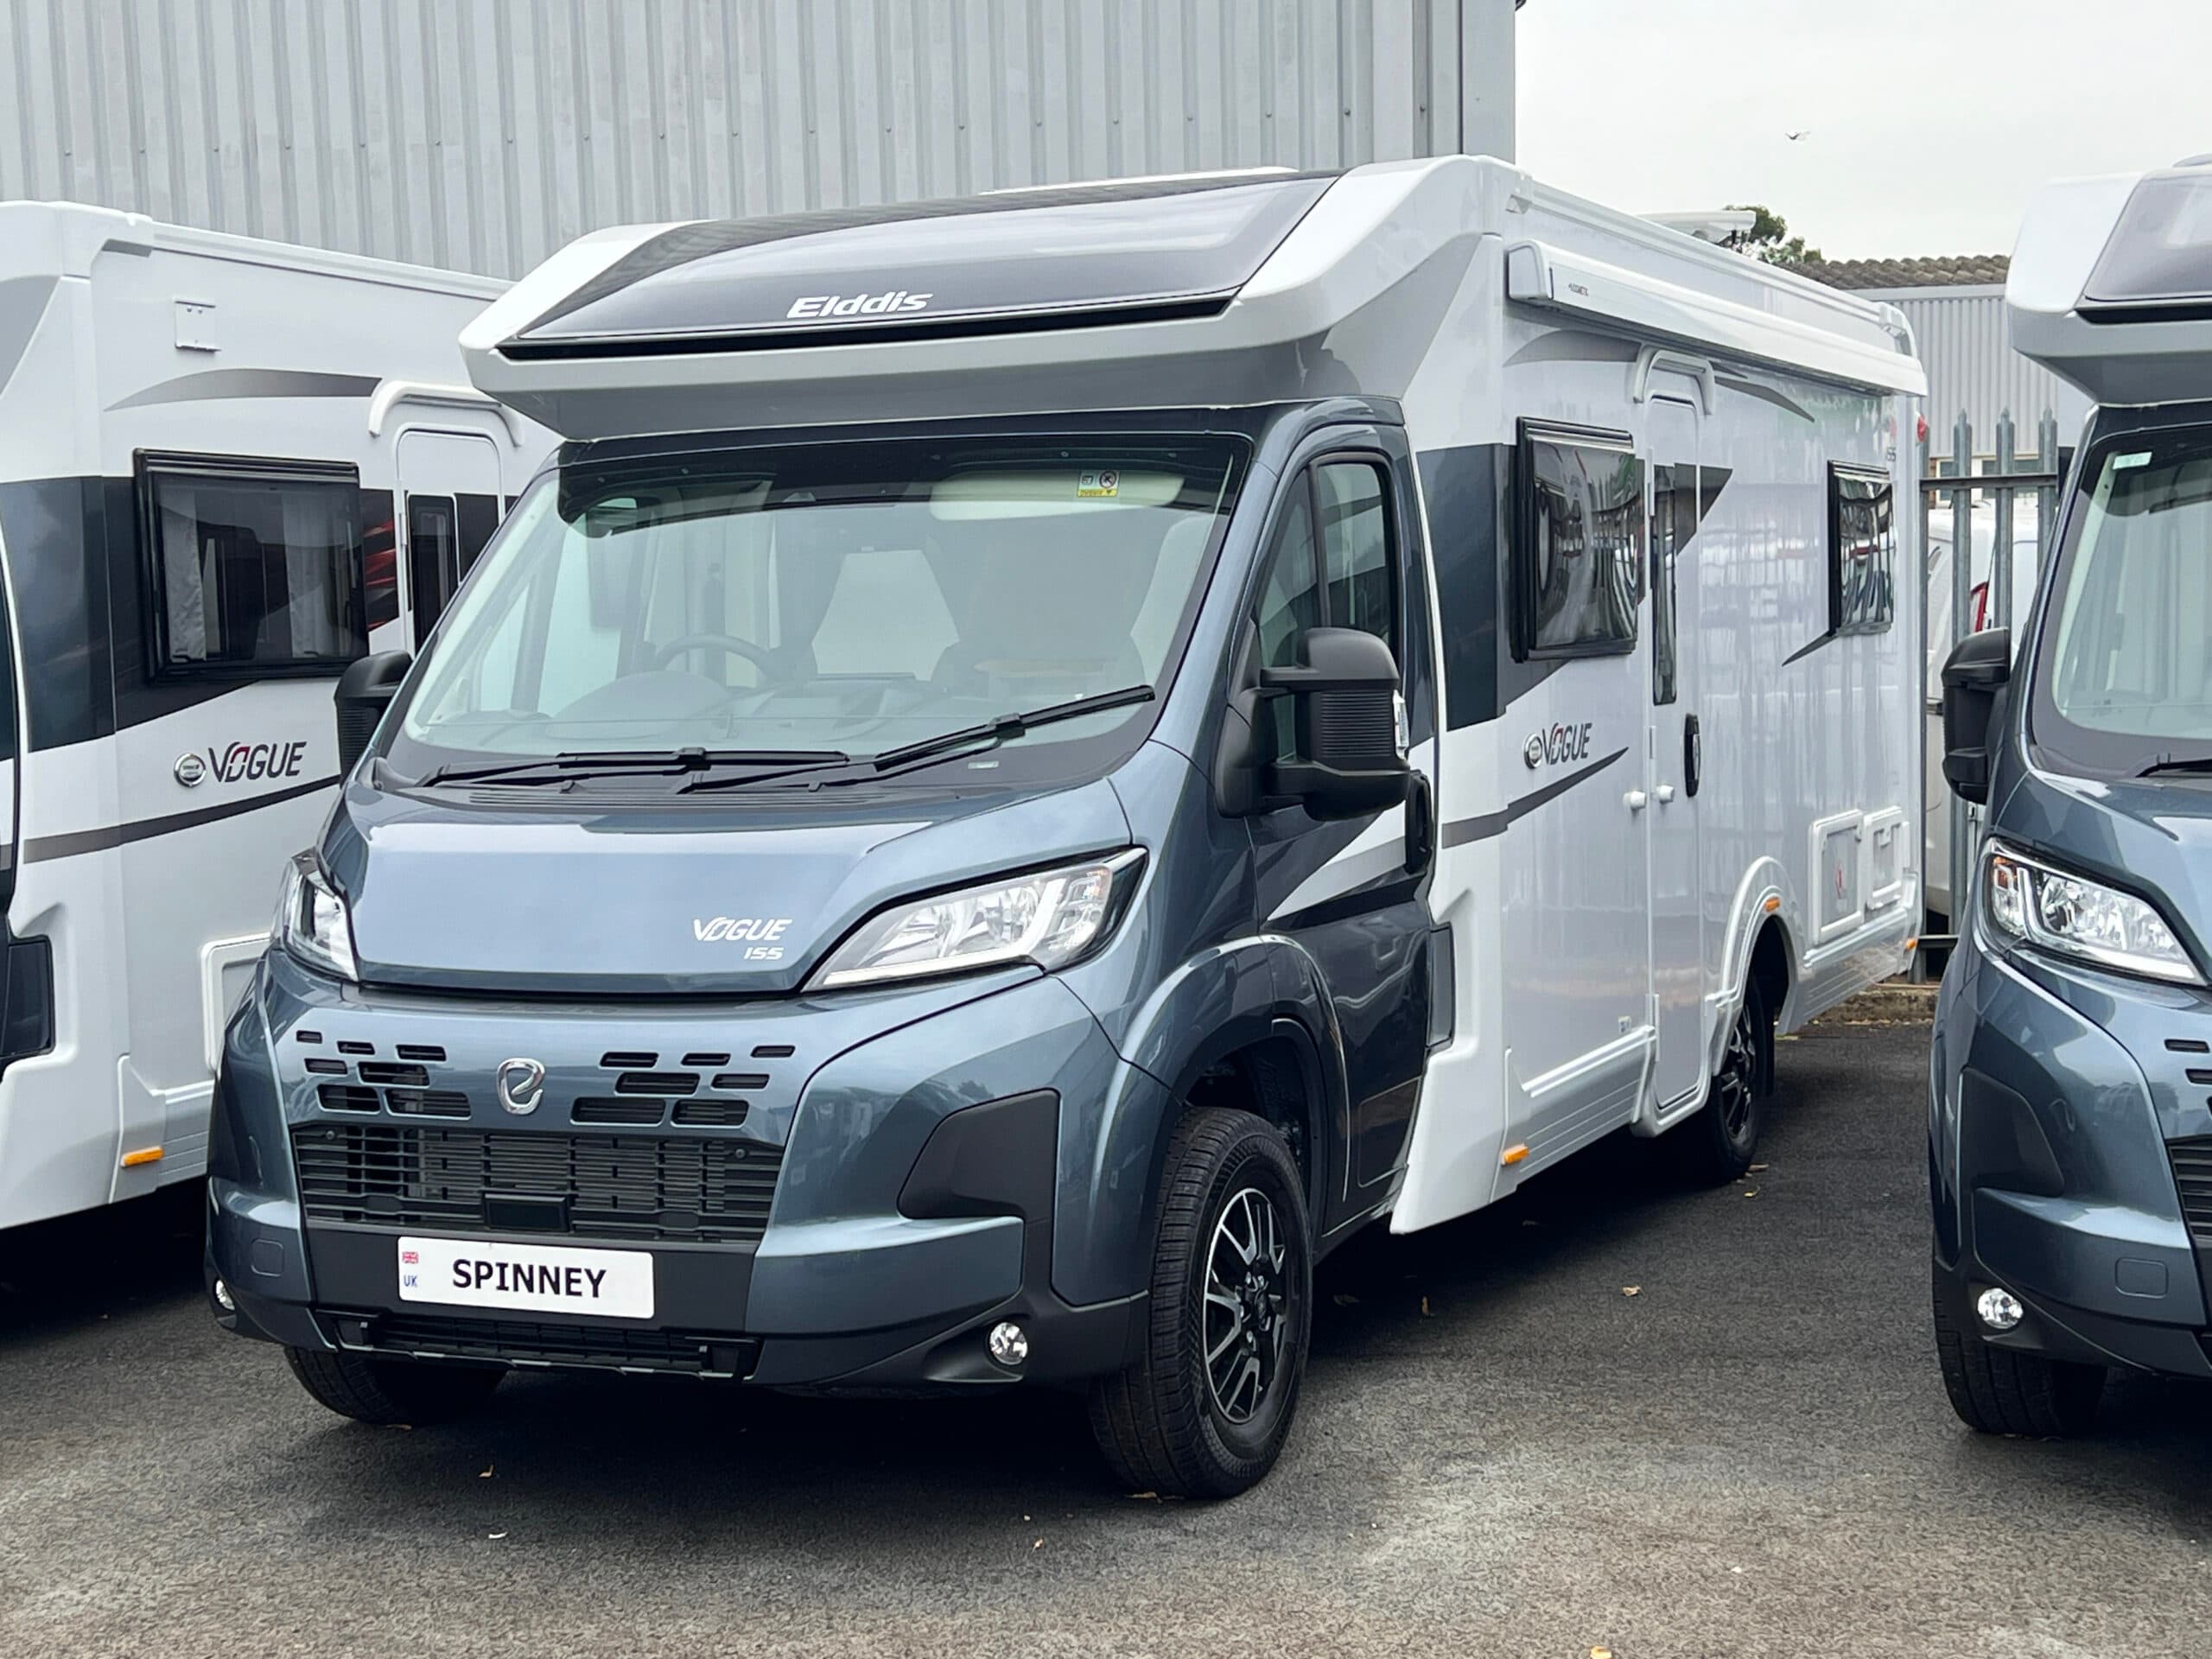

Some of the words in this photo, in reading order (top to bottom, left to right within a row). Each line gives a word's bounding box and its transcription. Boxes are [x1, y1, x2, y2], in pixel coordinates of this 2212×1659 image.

[786, 290, 934, 319] Elddis
[1541, 722, 1592, 765] VOGUE
[207, 741, 308, 783] VOGUE
[693, 916, 793, 941] VOGUE
[743, 947, 785, 960] 155
[403, 1274, 418, 1287] UK
[452, 1258, 607, 1298] SPINNEY
